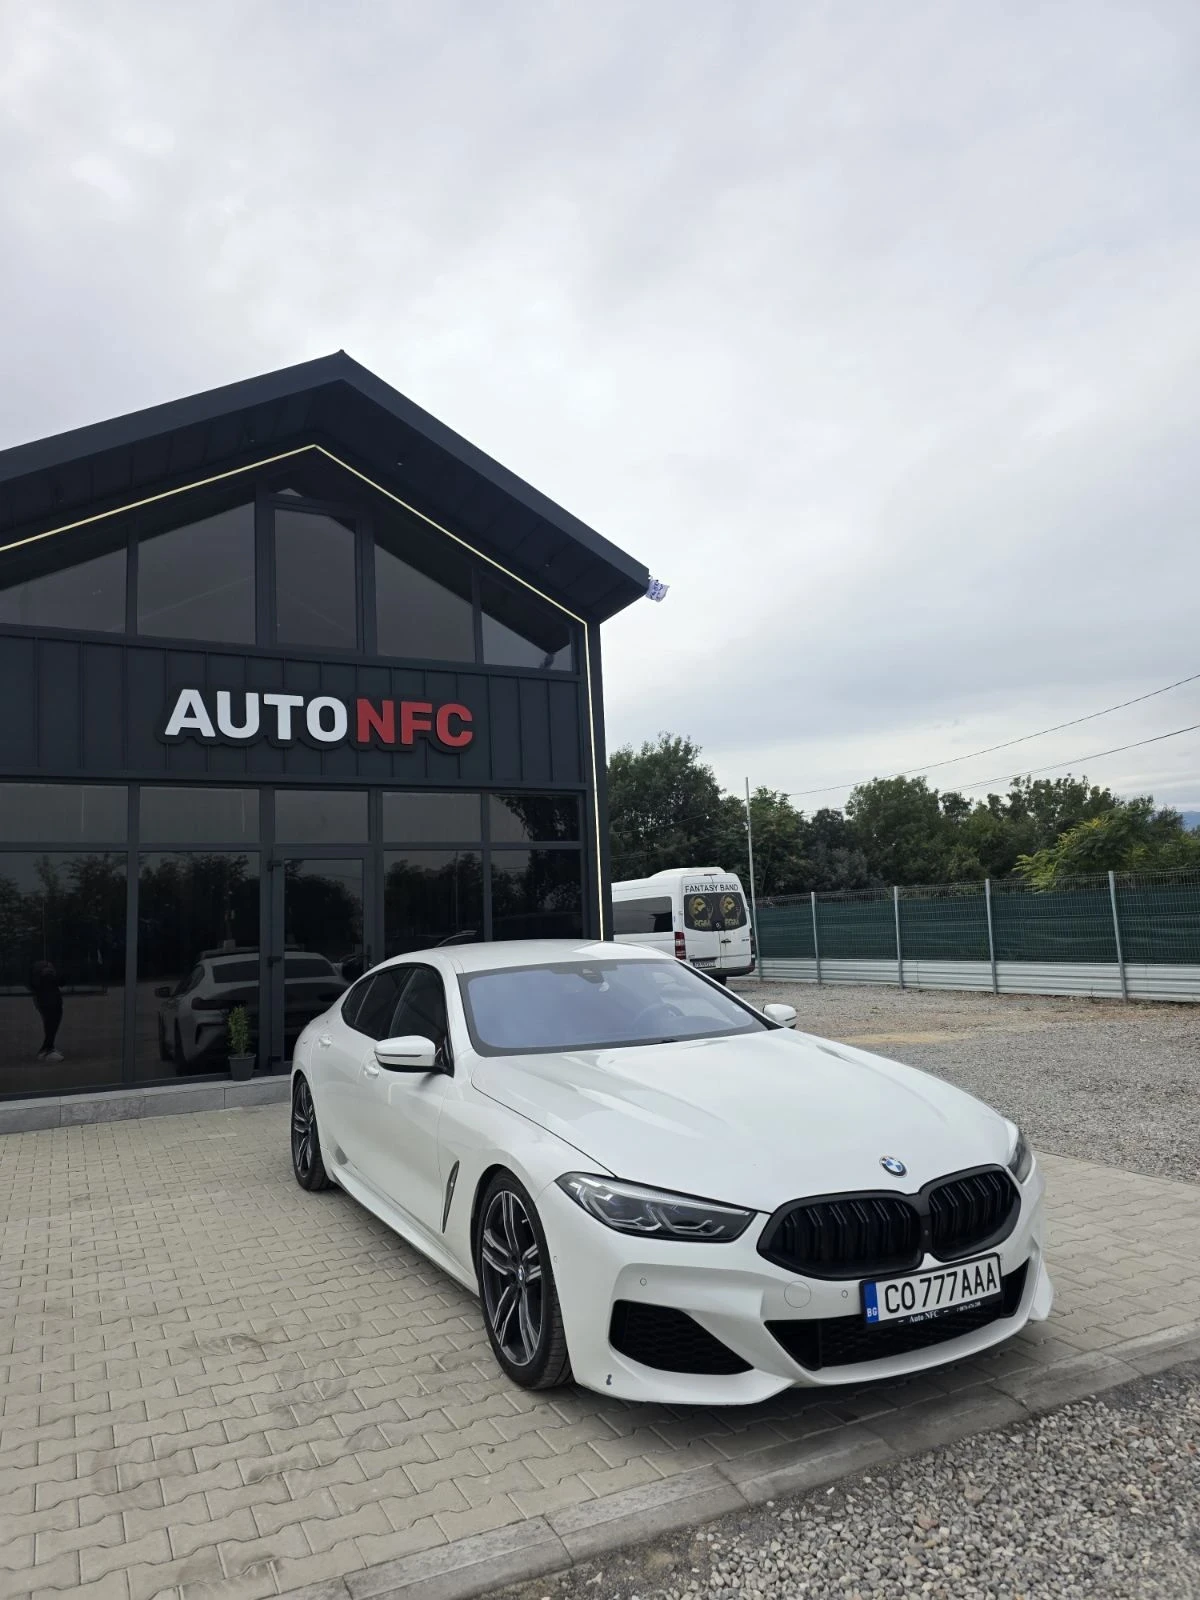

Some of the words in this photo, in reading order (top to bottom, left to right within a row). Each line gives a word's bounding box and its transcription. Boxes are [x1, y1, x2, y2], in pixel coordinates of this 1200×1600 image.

[684, 884, 718, 893] FANTASY
[720, 883, 739, 891] BAND
[866, 1307, 878, 1317] BG
[909, 1315, 924, 1323] Auto
[925, 1310, 940, 1319] NFC
